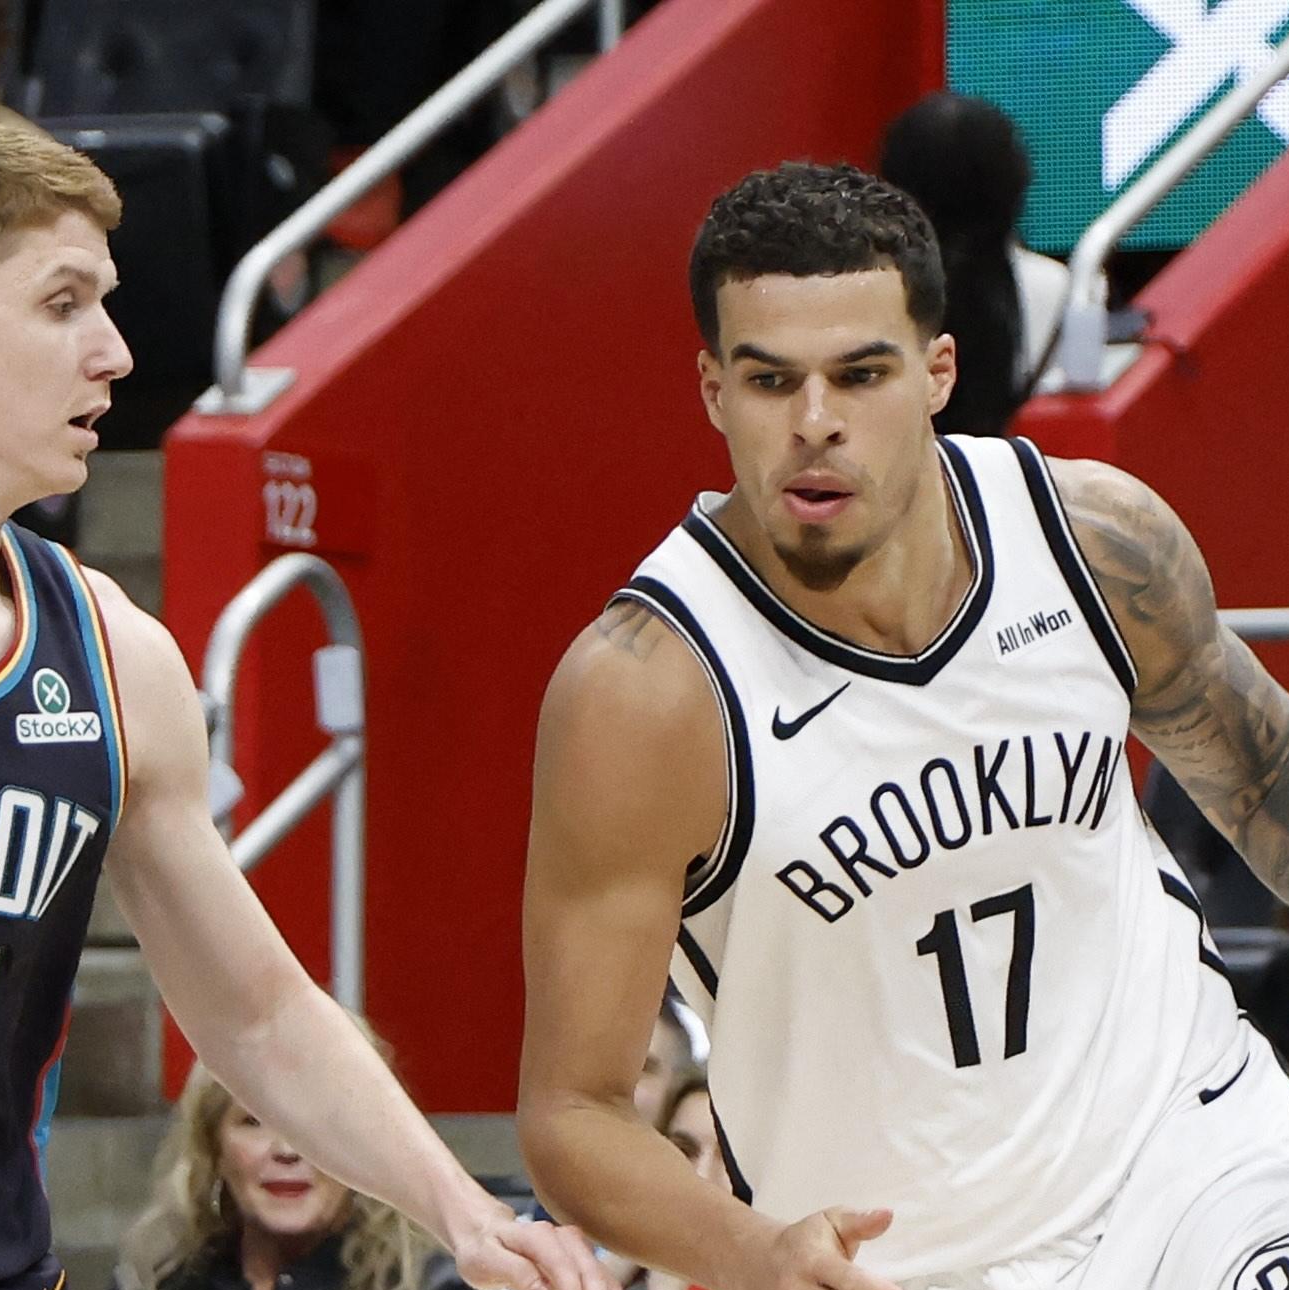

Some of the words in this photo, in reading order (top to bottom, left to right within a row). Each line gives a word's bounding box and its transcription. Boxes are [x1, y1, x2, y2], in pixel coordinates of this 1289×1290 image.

[997, 625, 1020, 656] All
[1016, 622, 1035, 645] In
[1028, 609, 1072, 637] Won
[19, 717, 96, 738] StockX
[774, 731, 1123, 924] BROOKLYN
[916, 882, 1035, 1069] 17
